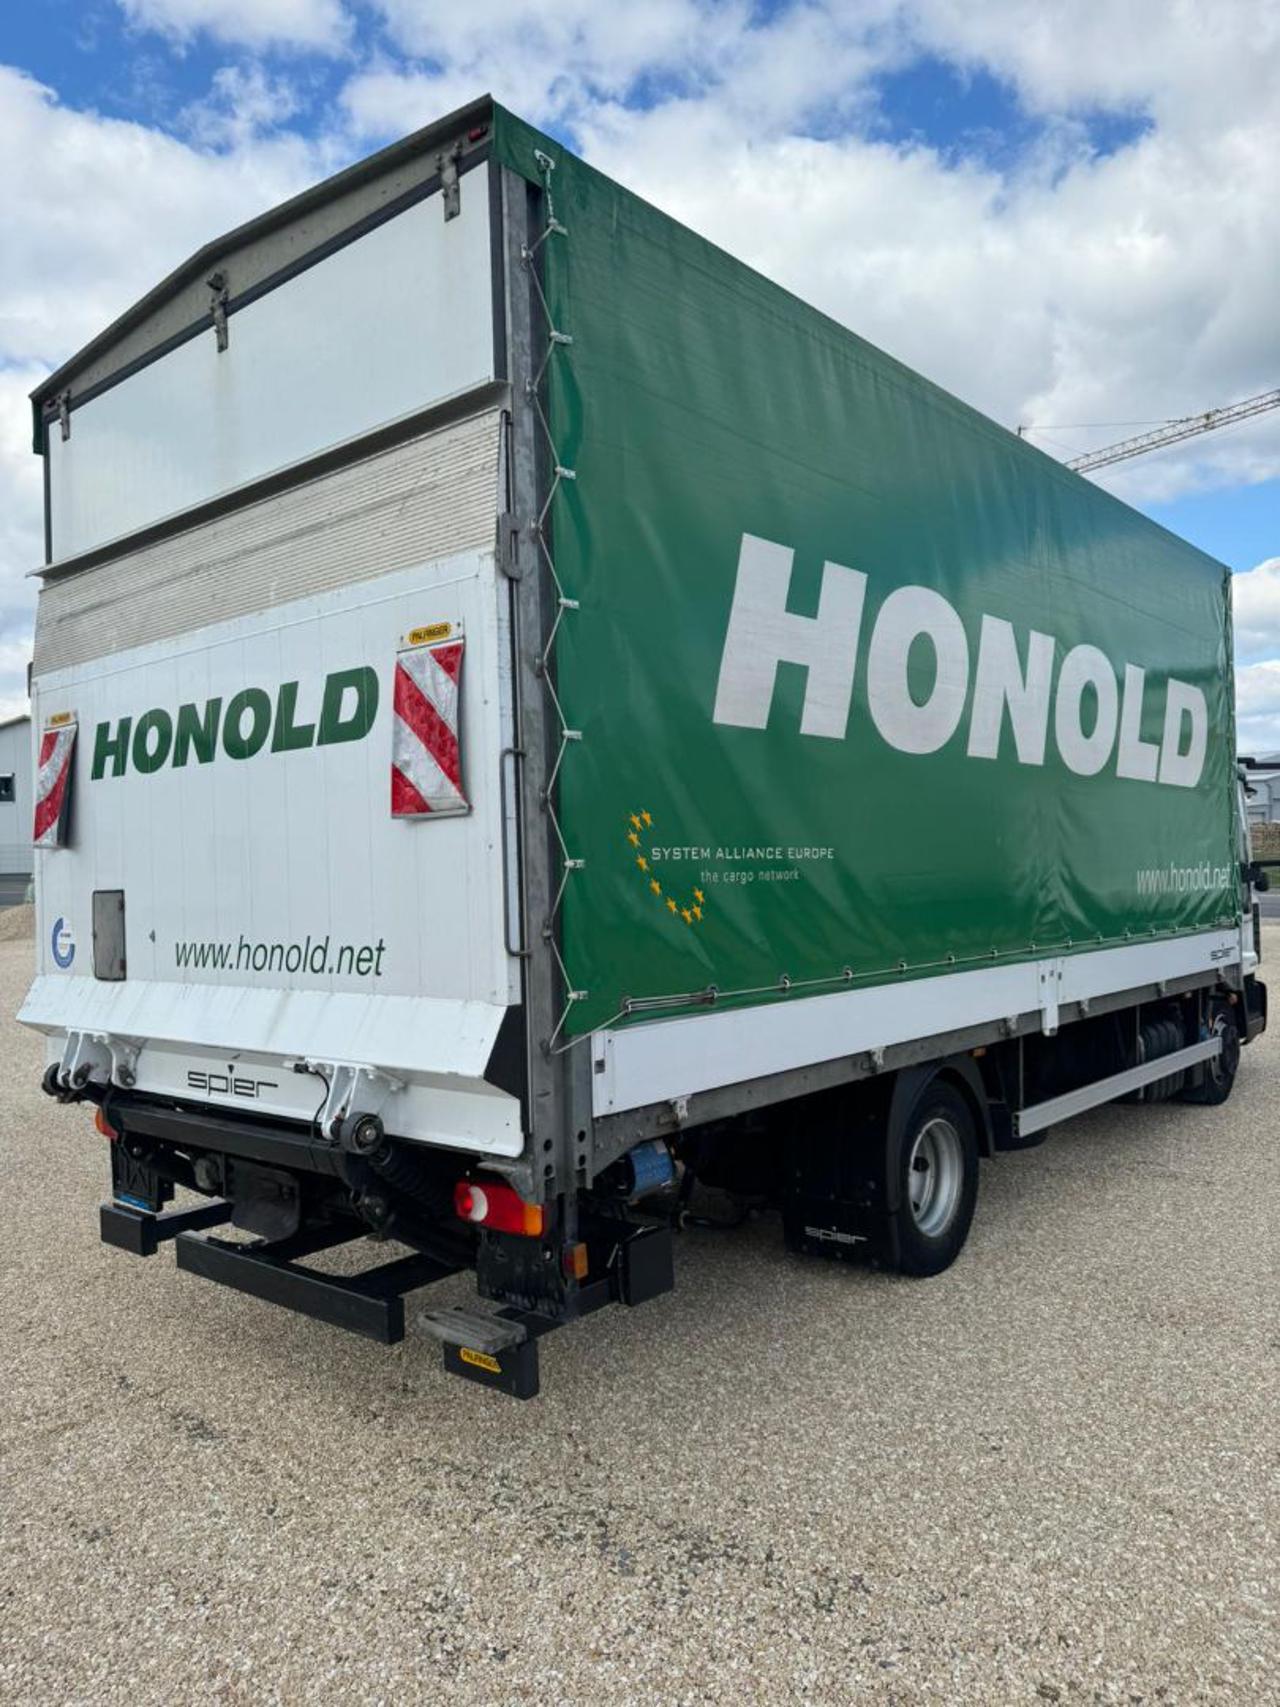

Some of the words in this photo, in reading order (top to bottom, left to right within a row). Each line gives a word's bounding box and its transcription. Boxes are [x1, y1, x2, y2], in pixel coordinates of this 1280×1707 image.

[713, 532, 1208, 788] HONOLD
[91, 665, 380, 780] HONOLD
[651, 847, 711, 860] SYSTEM
[715, 847, 783, 859] ALLIANCE
[788, 848, 835, 859] EUROPE
[701, 869, 720, 883] the
[723, 870, 753, 884] cargo
[758, 868, 800, 881] network
[1136, 861, 1231, 895] www.honold.net
[175, 934, 386, 976] www.honold.net
[187, 1064, 279, 1098] spier
[804, 1226, 868, 1245] spier
